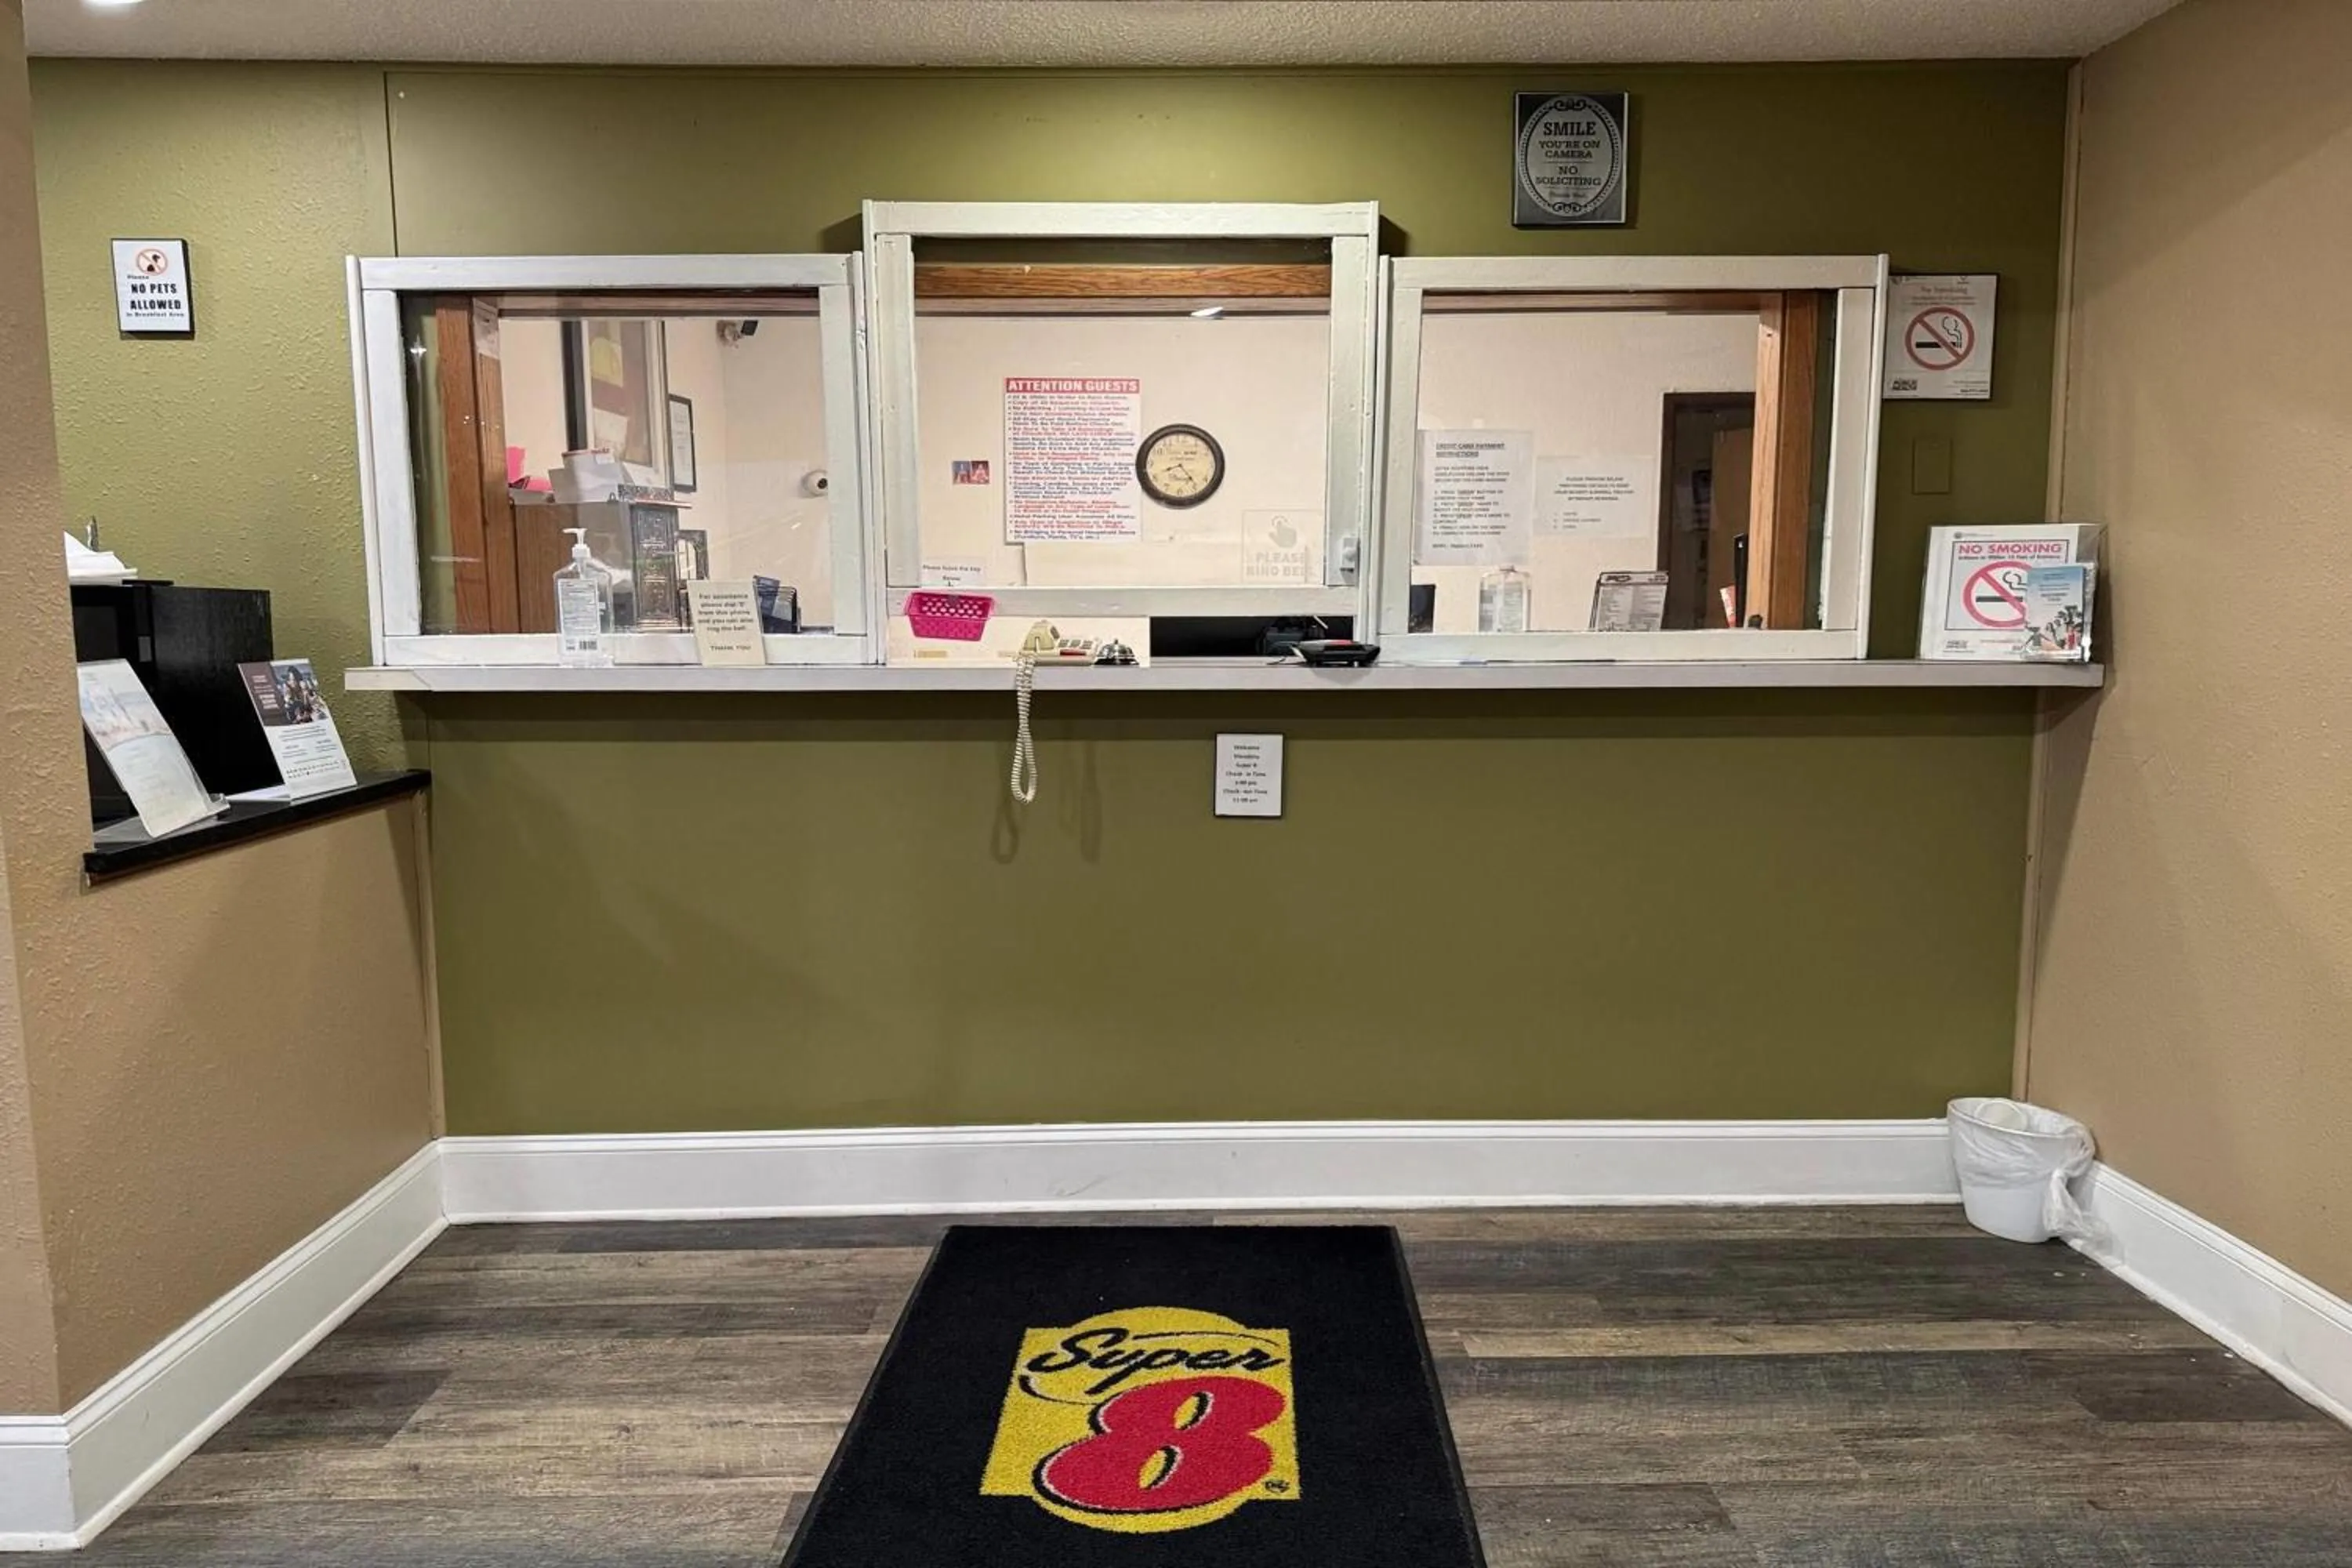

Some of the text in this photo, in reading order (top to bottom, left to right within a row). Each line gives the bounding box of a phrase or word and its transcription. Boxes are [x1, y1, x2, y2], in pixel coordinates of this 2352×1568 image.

[1543, 122, 1596, 136] SMILE
[1539, 140, 1600, 149] YOU'RE ON
[1544, 150, 1593, 158] CAMERA
[1559, 165, 1578, 175] NO
[1536, 176, 1601, 186] SOLICITING
[131, 283, 177, 294] NO PETS
[130, 299, 181, 310] ALLOWED
[1007, 380, 1138, 391] ATTENTION GUESTS
[1958, 543, 2061, 554] NO SMOKING
[1256, 552, 1305, 563] PLEASE
[1027, 1328, 1285, 1395] Super
[1031, 1374, 1287, 1514] 8
